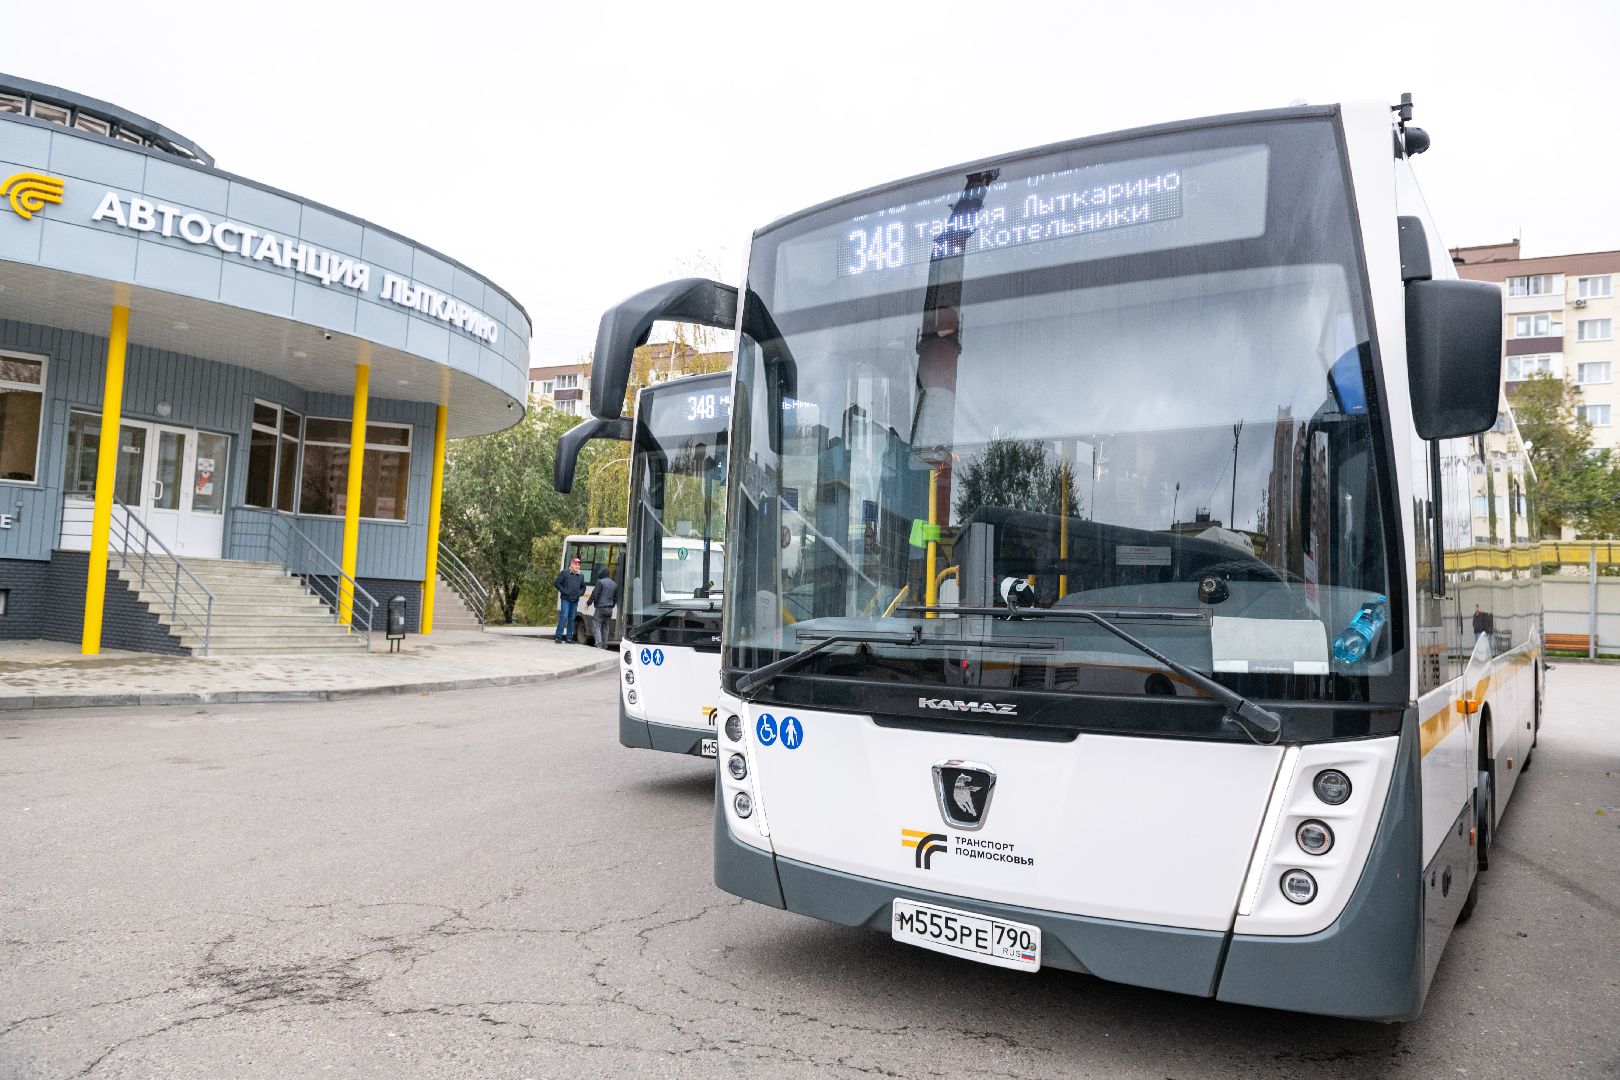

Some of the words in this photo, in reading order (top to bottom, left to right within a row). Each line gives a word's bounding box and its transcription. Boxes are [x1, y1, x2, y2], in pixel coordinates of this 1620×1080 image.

[1023, 172, 1180, 218] Лыткарино
[979, 203, 1149, 250] Котельники
[849, 221, 905, 275] 348
[91, 191, 370, 292] АВТОСТАНЦИЯ
[379, 273, 498, 344] ЛЫТКАРИНО
[687, 394, 715, 421] 348
[918, 697, 1018, 716] KAMAZ
[955, 836, 1015, 852] ТРАНСПОРТ
[955, 847, 1034, 866] ПОДМОСКОВЬЯ
[995, 925, 1031, 950] 790
